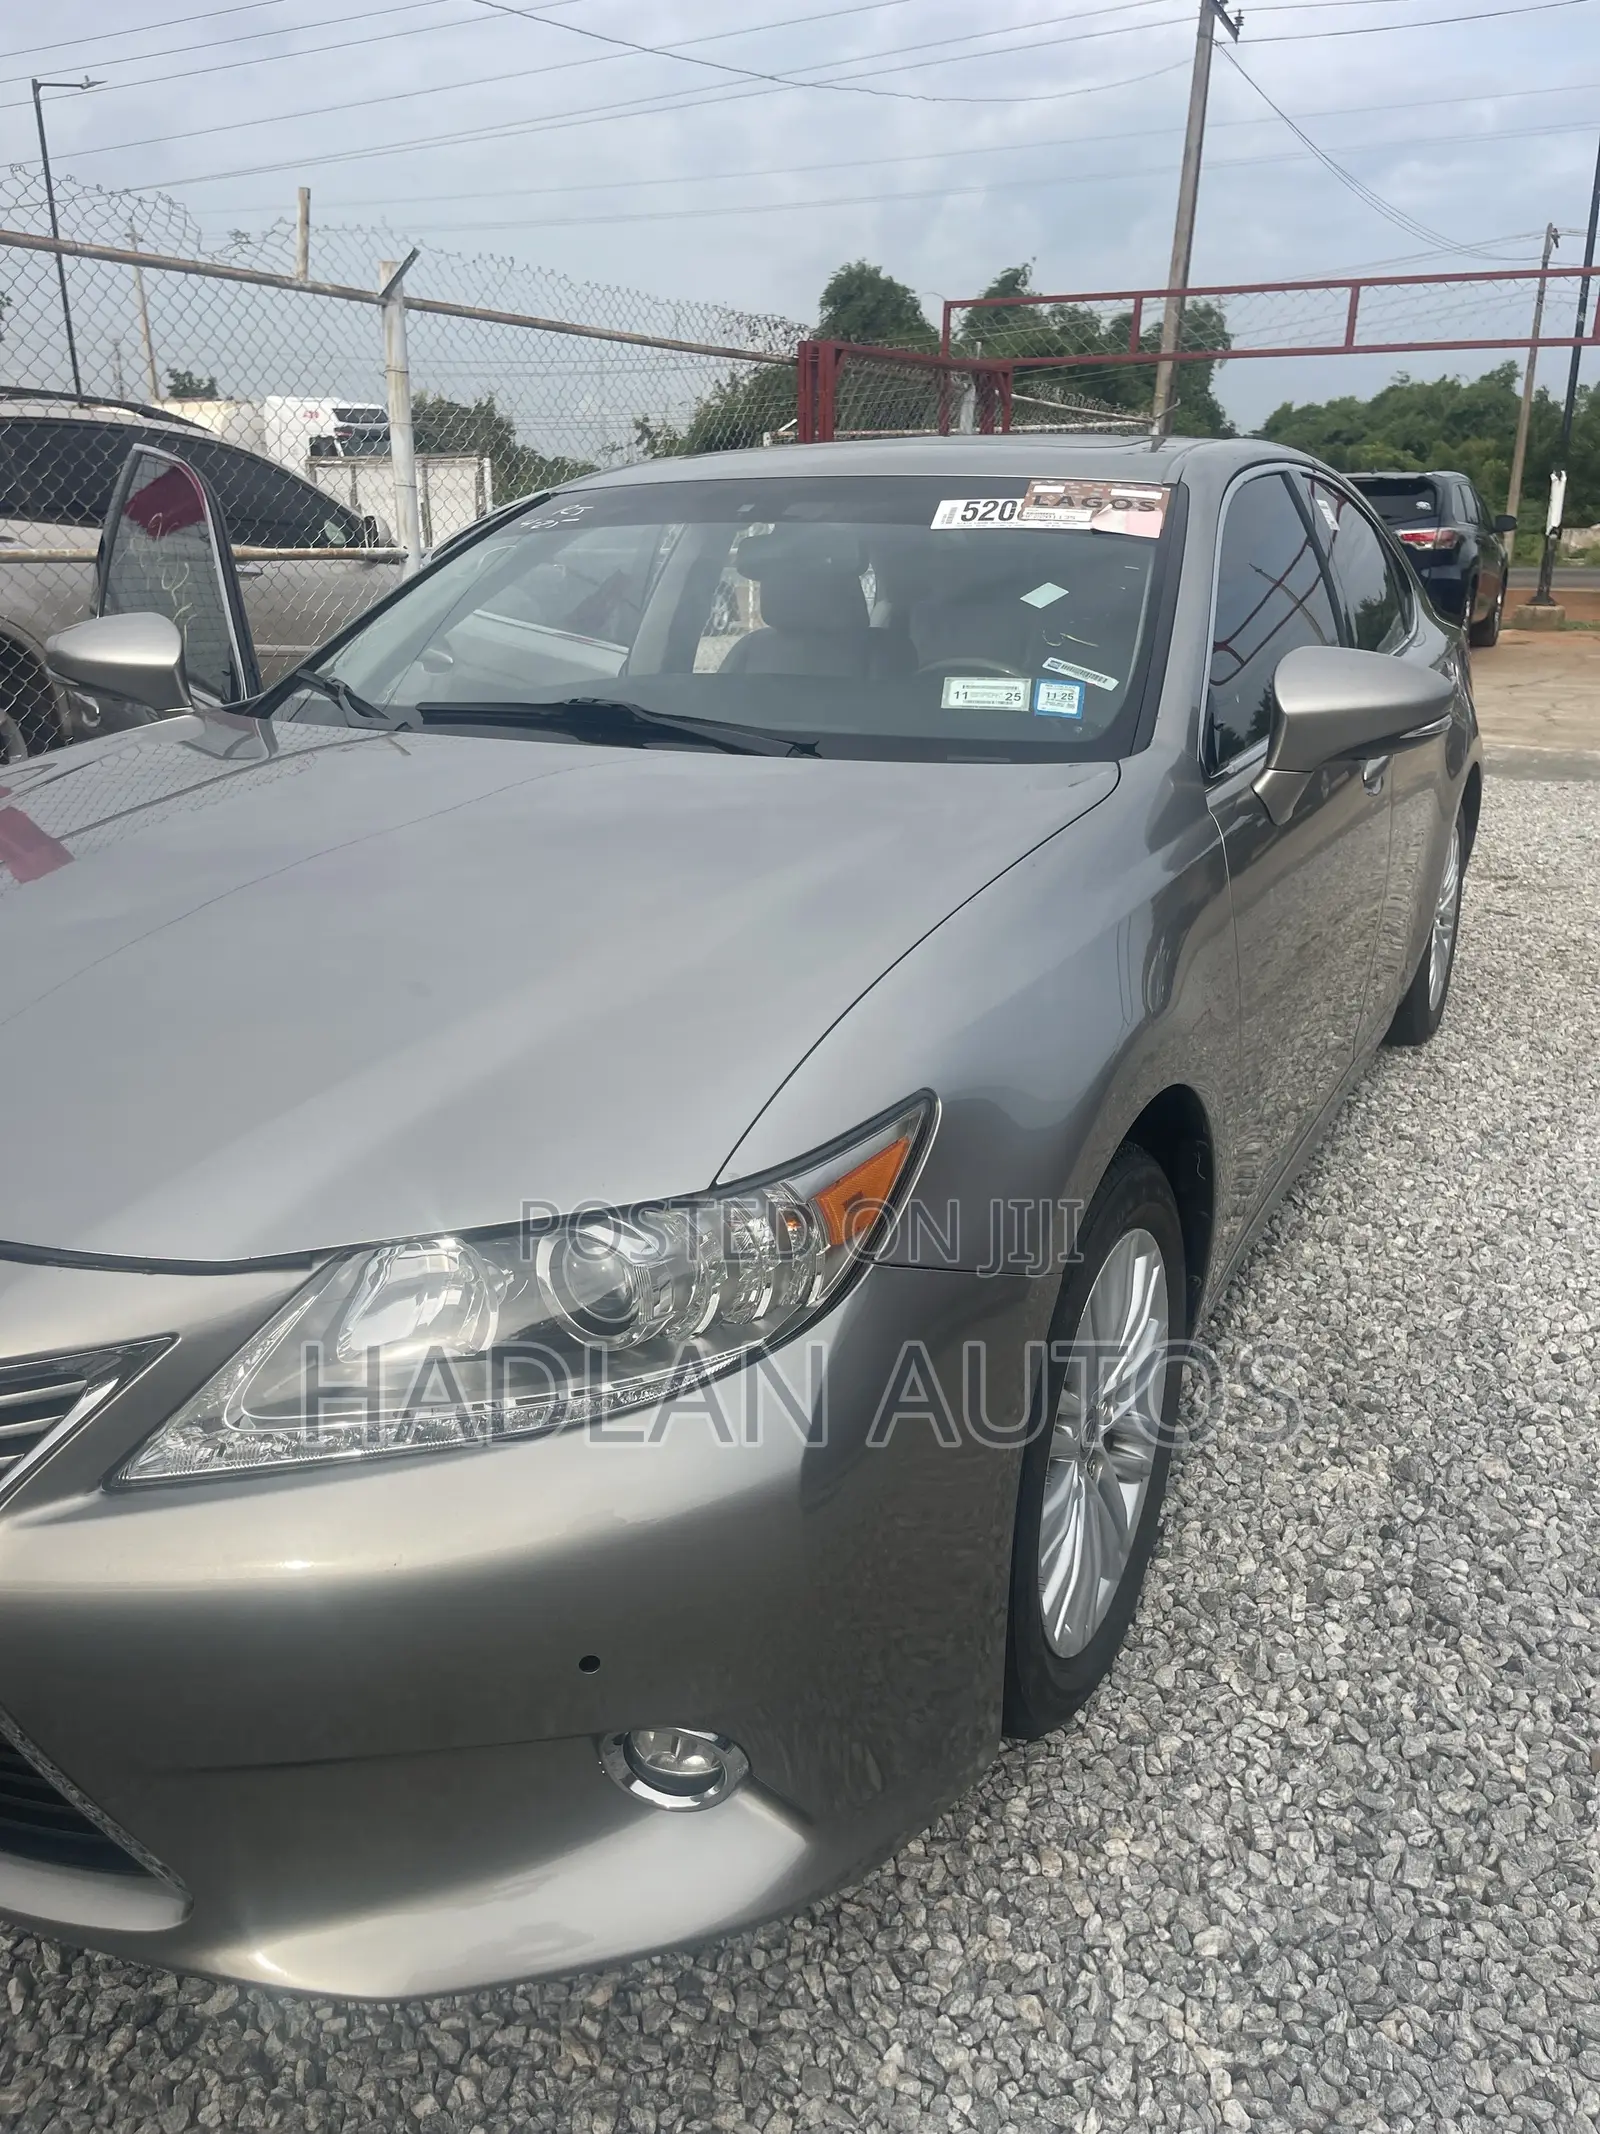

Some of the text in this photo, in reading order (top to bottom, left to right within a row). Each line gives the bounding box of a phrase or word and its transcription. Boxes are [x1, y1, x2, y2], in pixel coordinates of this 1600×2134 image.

[961, 500, 1026, 521] 520
[1033, 495, 1156, 512] LAGOS
[954, 690, 1021, 702] 11 25
[1061, 692, 1074, 701] 25
